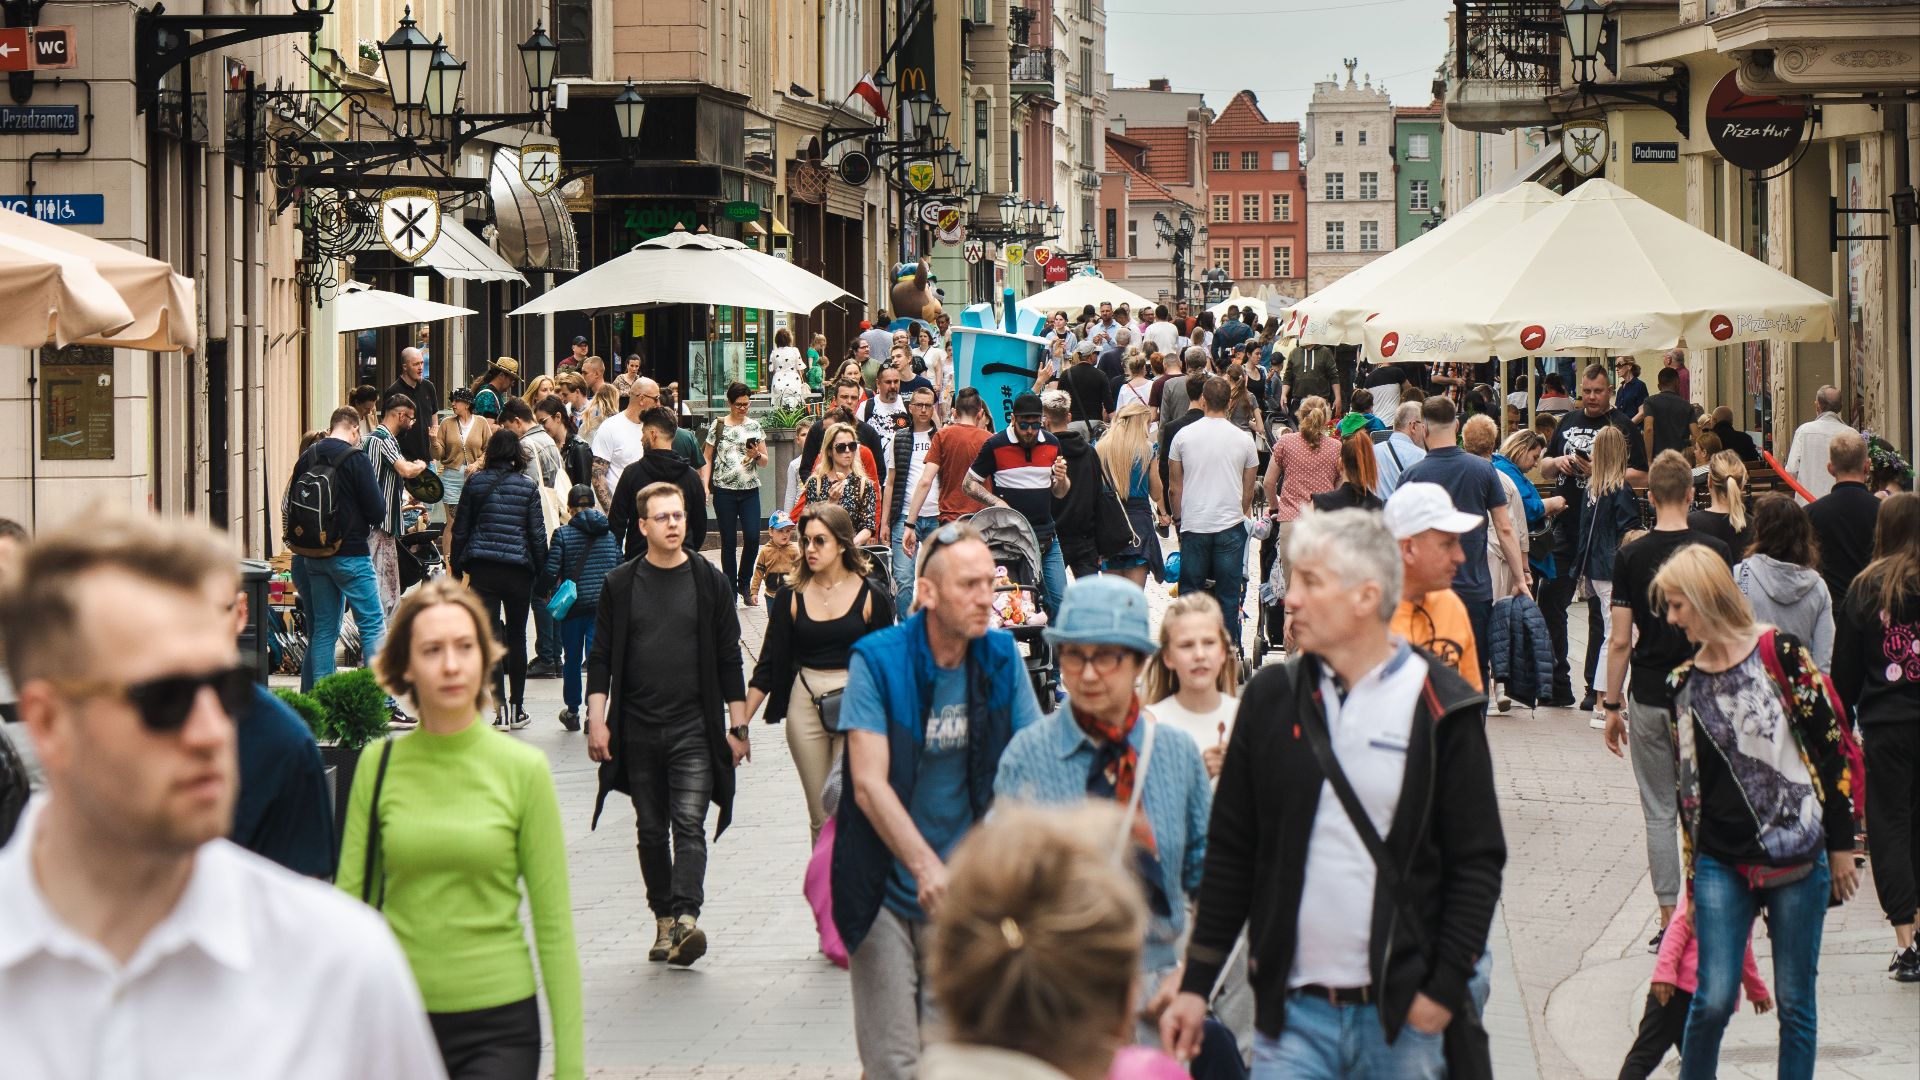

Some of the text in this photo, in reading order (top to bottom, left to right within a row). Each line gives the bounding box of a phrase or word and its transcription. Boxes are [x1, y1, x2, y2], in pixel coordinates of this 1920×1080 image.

[38, 40, 65, 55] WC
[3, 109, 75, 129] Przedzamcze
[1722, 123, 1793, 139] Pizza Hut
[1635, 146, 1676, 159] Podmurna
[0, 200, 28, 217] C
[1049, 265, 1066, 273] hebe
[1550, 321, 1650, 344] Pizza Hut
[1737, 312, 1807, 336] Pizza Hut
[1398, 331, 1465, 355] Pizza Hut
